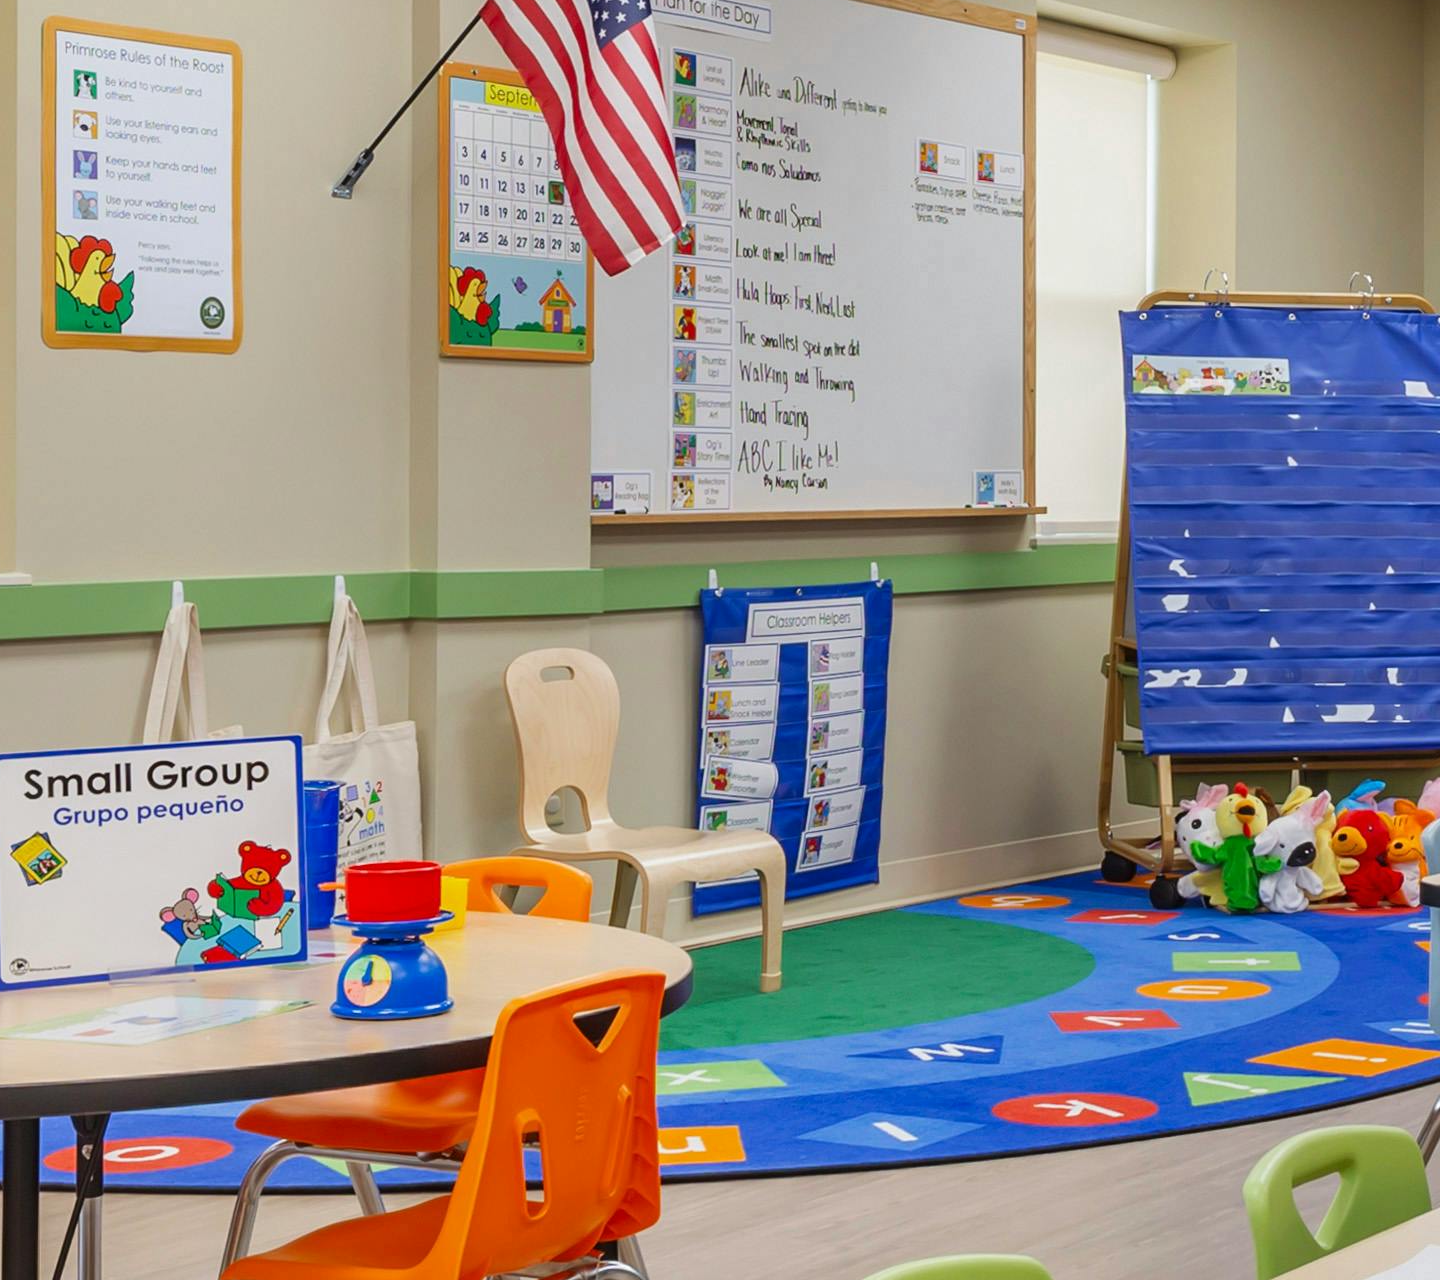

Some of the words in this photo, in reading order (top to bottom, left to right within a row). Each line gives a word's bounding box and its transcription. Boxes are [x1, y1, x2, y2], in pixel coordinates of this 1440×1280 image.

[710, 1, 730, 19] the
[734, 5, 761, 29] Day
[65, 41, 117, 60] Primrose
[120, 48, 152, 65] Rules
[154, 54, 166, 67] of
[169, 55, 189, 70] the
[192, 58, 225, 75] Roost
[104, 76, 117, 87] Be
[119, 79, 137, 89] kind
[139, 81, 149, 91] to
[150, 83, 183, 94] yourself
[184, 87, 202, 97] and
[105, 92, 135, 102] others.
[739, 67, 772, 98] Alike
[792, 75, 838, 111] Different
[699, 102, 729, 117] Harmony
[105, 116, 121, 126] Use
[123, 119, 143, 129] your
[144, 117, 179, 134] listening
[181, 124, 199, 135] ears
[200, 126, 218, 137] and
[105, 129, 138, 143] looking
[139, 134, 162, 144] eyes.
[105, 155, 129, 168] Keep
[131, 160, 151, 169] your
[153, 161, 179, 172] hands
[181, 163, 199, 173] and
[200, 165, 217, 175] feet
[459, 174, 470, 186] 10
[479, 178, 489, 190] 11
[498, 180, 508, 193] 12
[516, 182, 526, 194] 13
[535, 184, 545, 196] 14
[105, 195, 122, 205] Use
[123, 198, 143, 208] your
[145, 198, 178, 211] walking
[180, 201, 197, 211] feet
[198, 203, 216, 214] and
[459, 203, 469, 215] 17
[479, 205, 490, 217] 18
[498, 207, 508, 219] 19
[516, 209, 528, 221] 20
[534, 211, 545, 223] 21
[552, 214, 563, 225] 22
[570, 215, 579, 226] 2
[738, 197, 753, 220] We
[756, 206, 772, 223] are
[774, 208, 787, 226] all
[790, 203, 822, 233] Special
[105, 210, 132, 220] inside
[133, 213, 158, 221] voice
[159, 212, 168, 222] in
[169, 213, 199, 225] school.
[459, 231, 471, 243] 24
[478, 232, 489, 244] 25
[498, 234, 509, 247] 26
[516, 237, 528, 249] 27
[534, 238, 545, 250] 28
[551, 238, 562, 250] 29
[570, 241, 581, 254] 30
[735, 238, 759, 259] Look
[762, 246, 772, 261] at
[798, 248, 812, 262] am
[736, 277, 760, 301] Hula
[736, 320, 756, 346] The
[760, 333, 799, 353] smallest
[802, 339, 821, 359] spot
[738, 359, 789, 394] Walking
[794, 368, 810, 385] and
[812, 365, 855, 403] Throwing
[740, 400, 767, 426] Hand
[772, 399, 809, 441] Tracing
[737, 439, 774, 474] ABC
[776, 440, 787, 472] I
[791, 443, 813, 471] like
[817, 440, 839, 469] Me!
[763, 473, 774, 492] By
[775, 475, 799, 495] Nancy
[767, 615, 817, 629] Classroom
[818, 612, 851, 627] Helpers
[23, 762, 132, 800] Small
[147, 760, 270, 791] Group
[364, 781, 372, 793] 3
[53, 806, 129, 827] Grupo
[137, 795, 245, 824] pequeño
[359, 820, 385, 840] math
